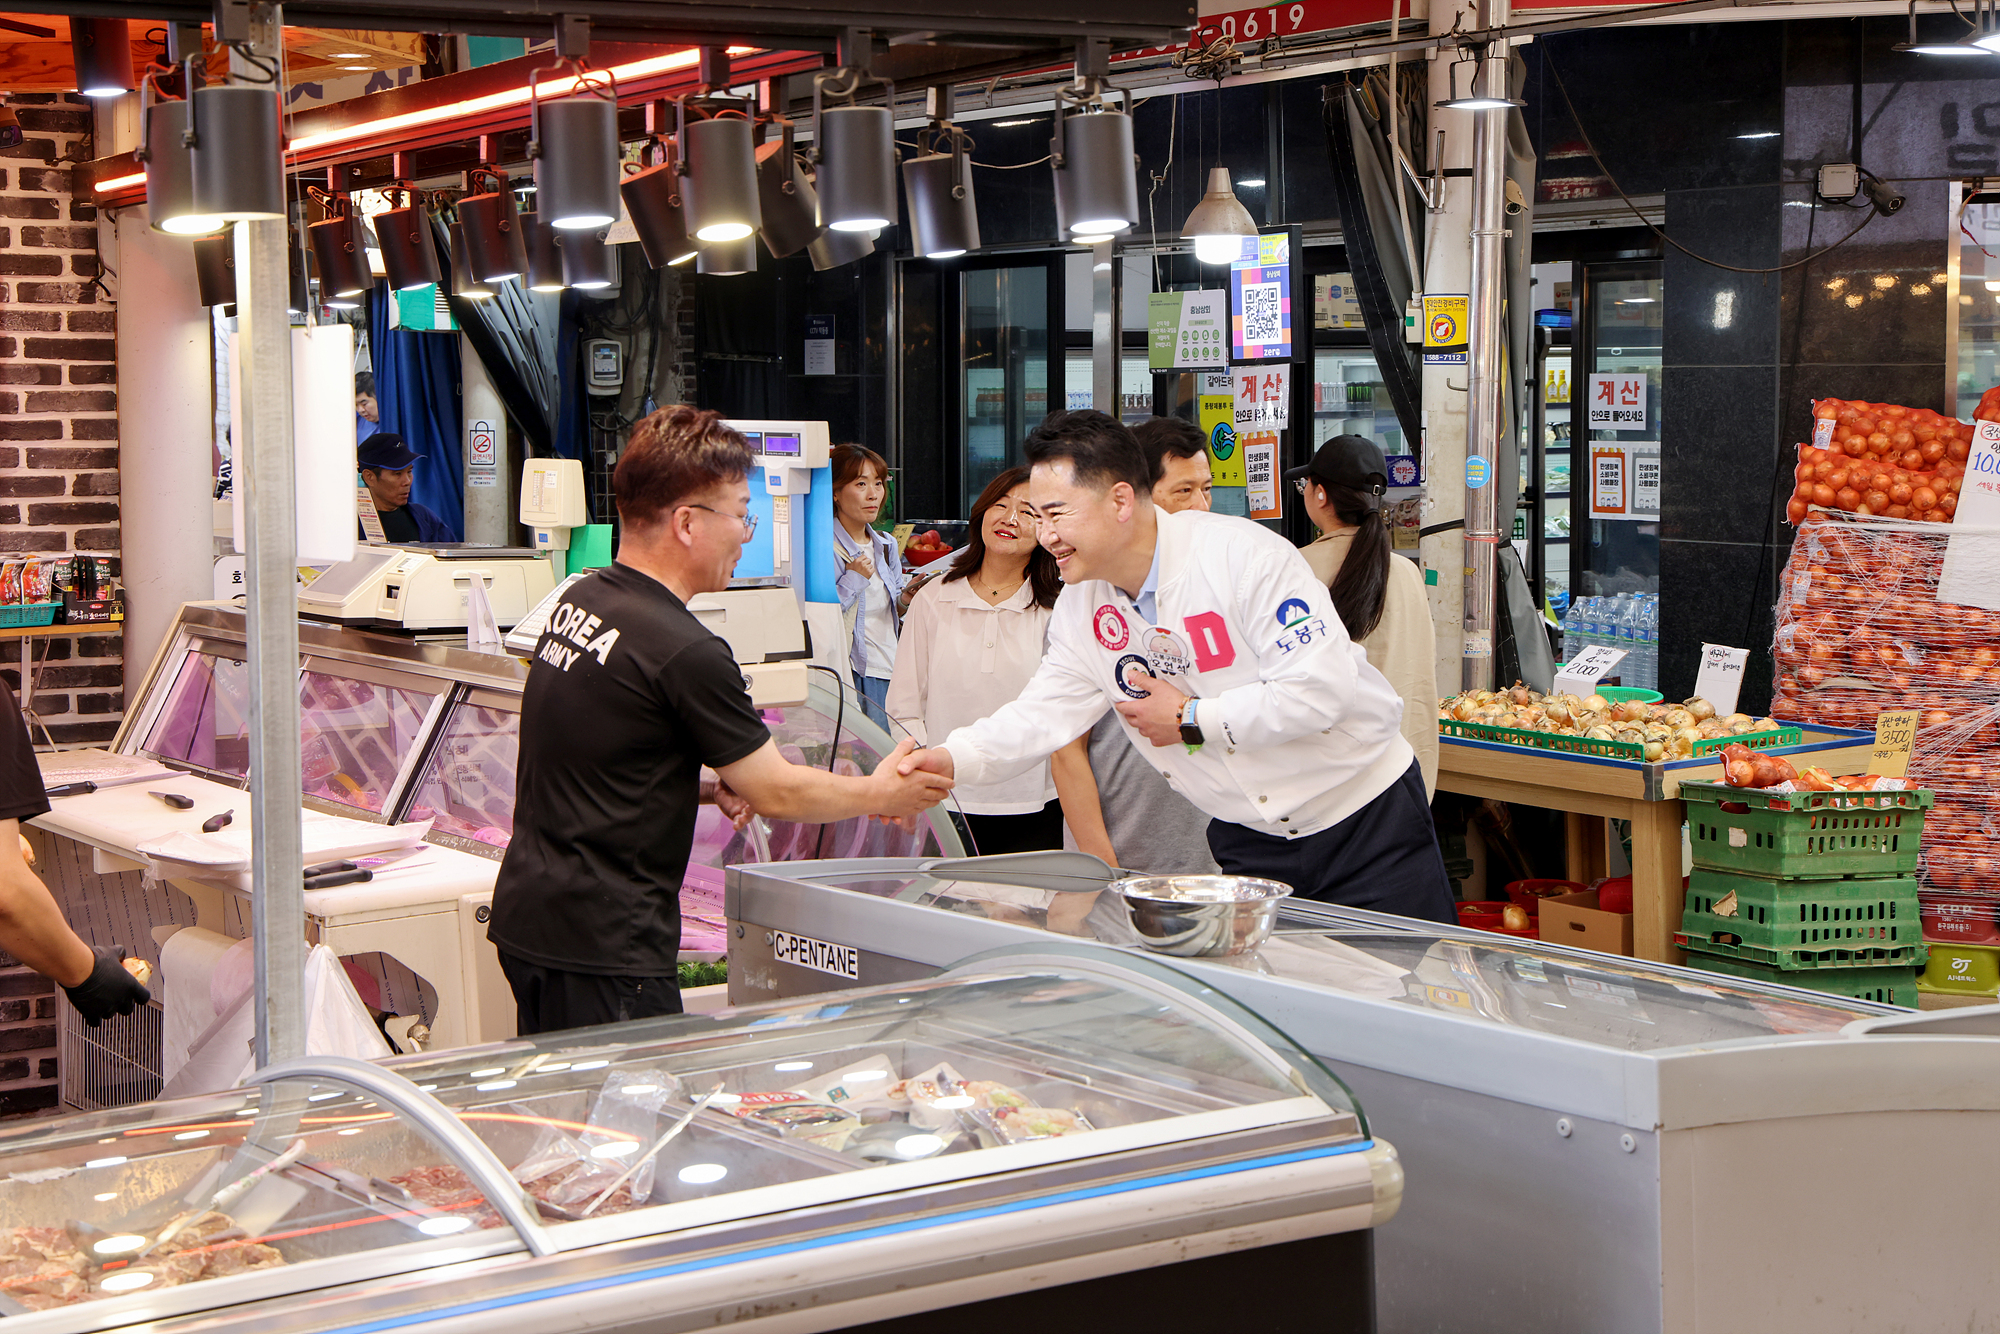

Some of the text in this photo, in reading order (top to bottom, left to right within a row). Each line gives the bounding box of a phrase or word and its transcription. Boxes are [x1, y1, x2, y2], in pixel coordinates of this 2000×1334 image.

[1241, 373, 1282, 403] 계산
[1597, 380, 1640, 405] 계산
[1204, 402, 1227, 410] 종량제봉투
[1235, 409, 1252, 423] 안으로
[1591, 410, 1644, 422] 안으로 들어오세요
[472, 453, 493, 461] 금연시장
[1248, 452, 1270, 462] 민생회복
[1248, 462, 1270, 472] 소비쿠폰
[1395, 467, 1414, 475] 박카스
[1248, 472, 1270, 483] 사용매장
[1183, 610, 1236, 673] D
[1275, 619, 1327, 655] 도봉구
[538, 638, 581, 672] ARMY
[1119, 655, 1136, 667] SEOUL
[1152, 652, 1183, 664] 도봉구청장
[1880, 729, 1911, 745] 3500
[1936, 904, 1972, 915] KPP
[775, 933, 857, 976] C-PENTANE
